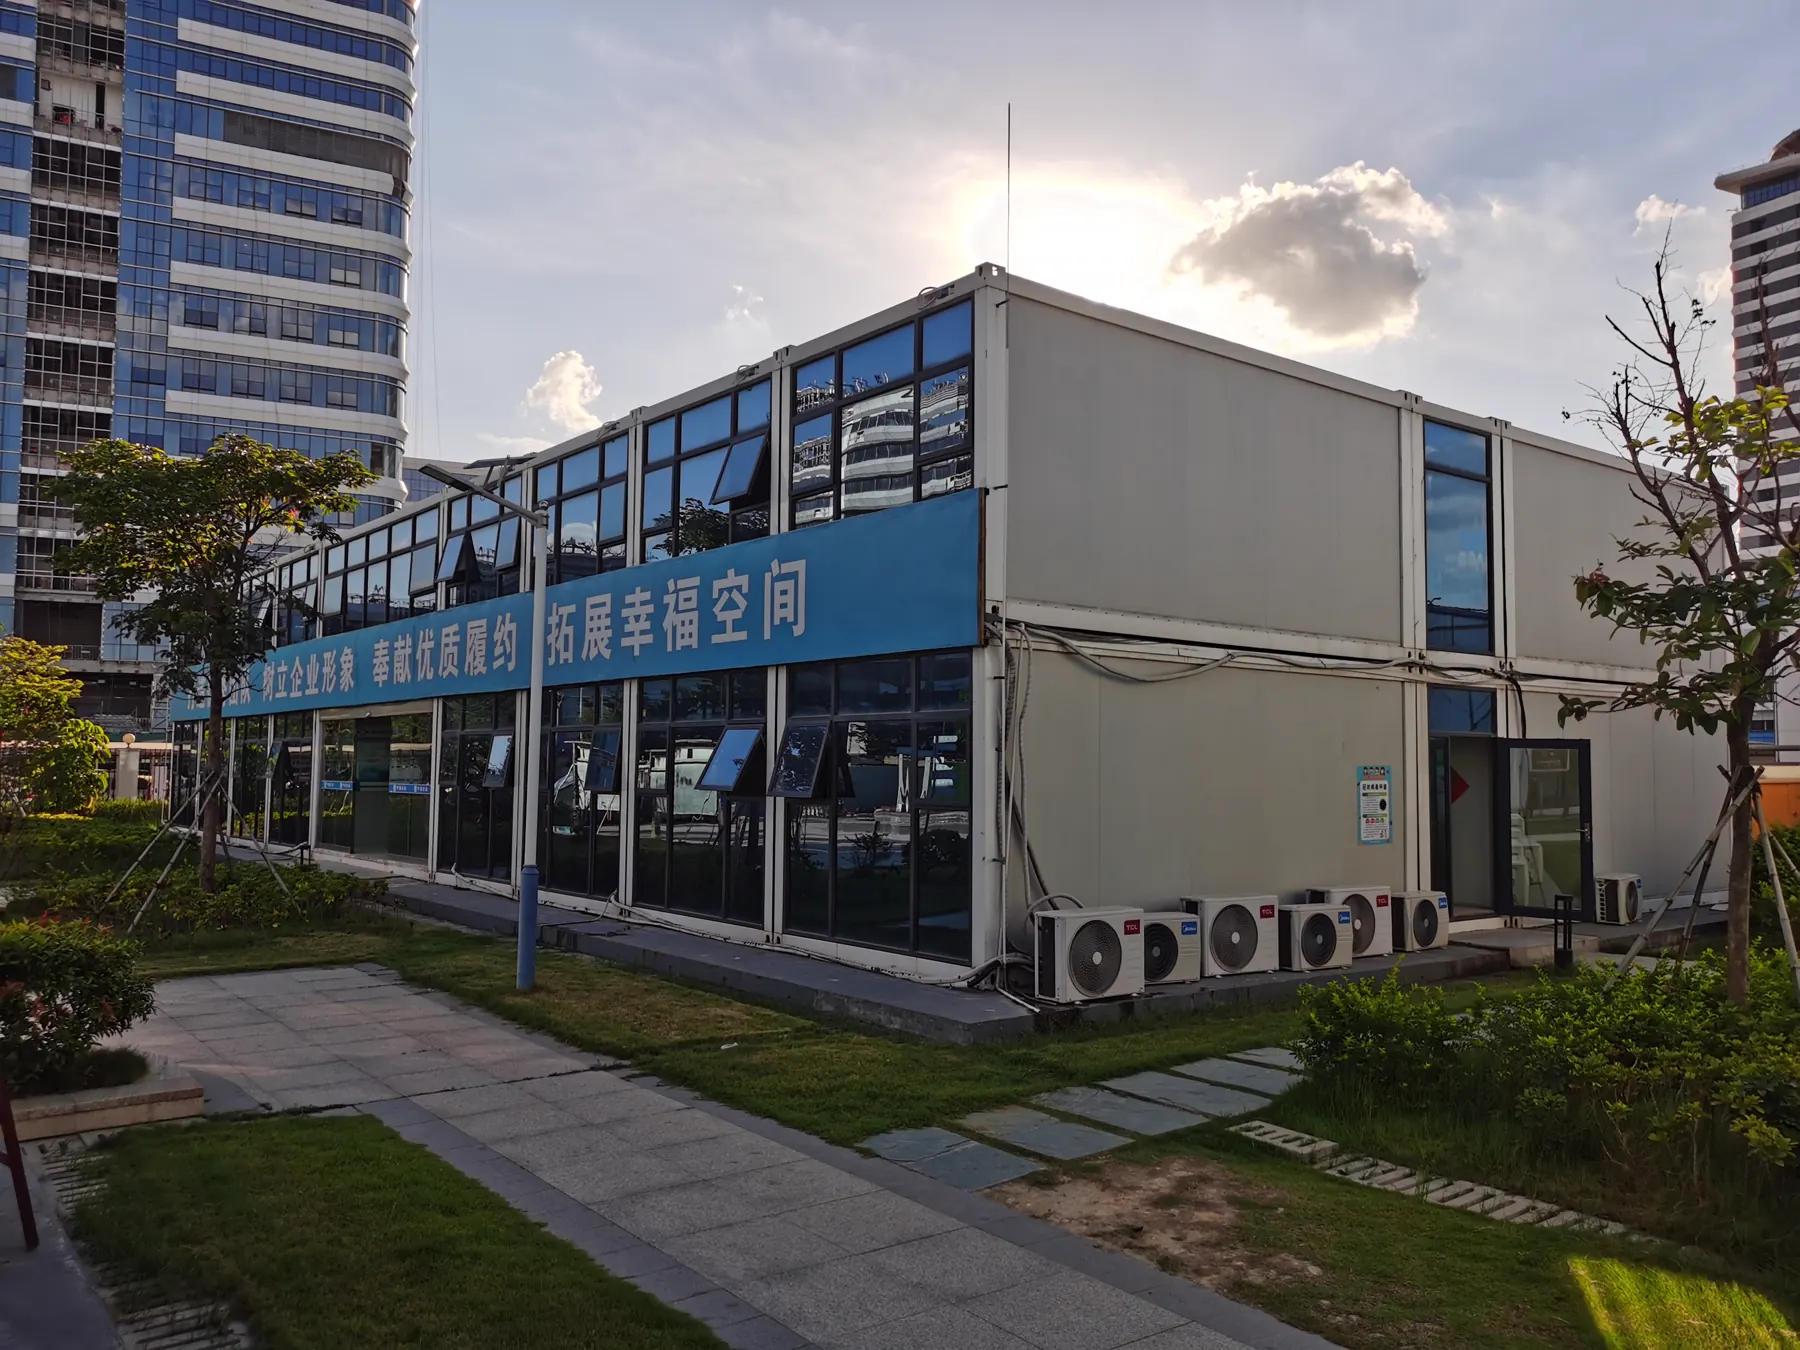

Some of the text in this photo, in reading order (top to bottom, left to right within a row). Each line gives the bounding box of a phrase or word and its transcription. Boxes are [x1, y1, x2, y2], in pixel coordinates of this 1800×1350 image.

[262, 645, 355, 702] 树立企业形象
[372, 612, 517, 688] 奉献优质履约
[547, 558, 807, 666] 拓展幸福空间
